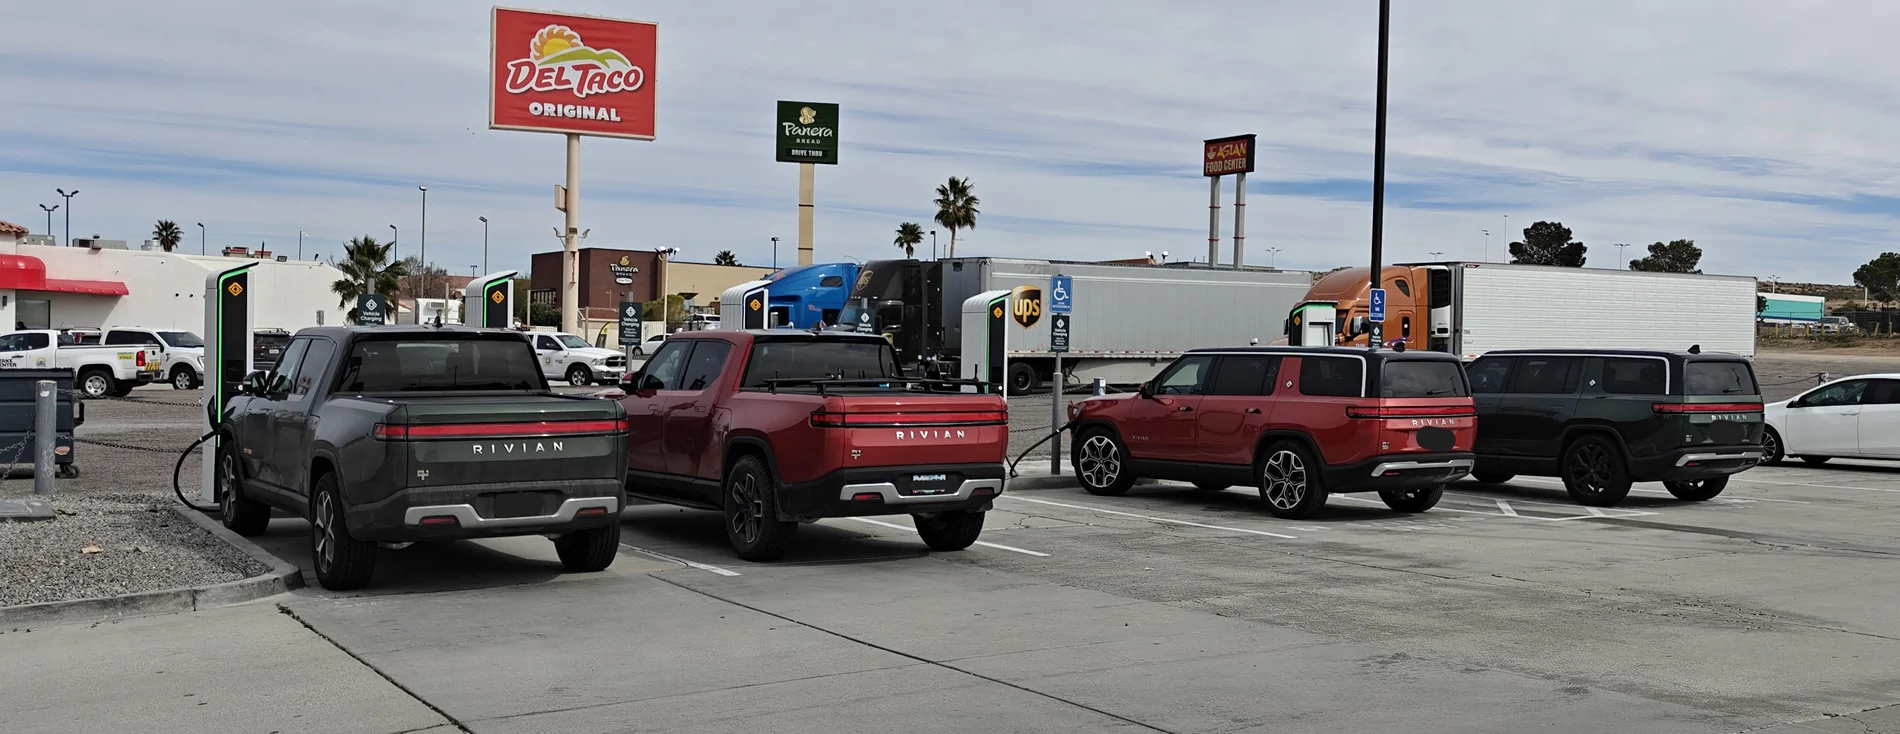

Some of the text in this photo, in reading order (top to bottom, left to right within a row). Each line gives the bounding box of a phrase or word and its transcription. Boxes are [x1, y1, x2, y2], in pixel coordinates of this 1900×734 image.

[529, 102, 622, 122] ORIGINAL
[782, 122, 833, 137] Panera
[1217, 142, 1247, 158] ASIAN
[1205, 157, 1247, 173] FOOD CENTER
[1014, 298, 1040, 323] ups
[360, 315, 382, 323] Charging
[1411, 418, 1455, 427] RIVIAN
[896, 430, 965, 440] RIVIAN
[473, 441, 563, 454] RIVIAN
